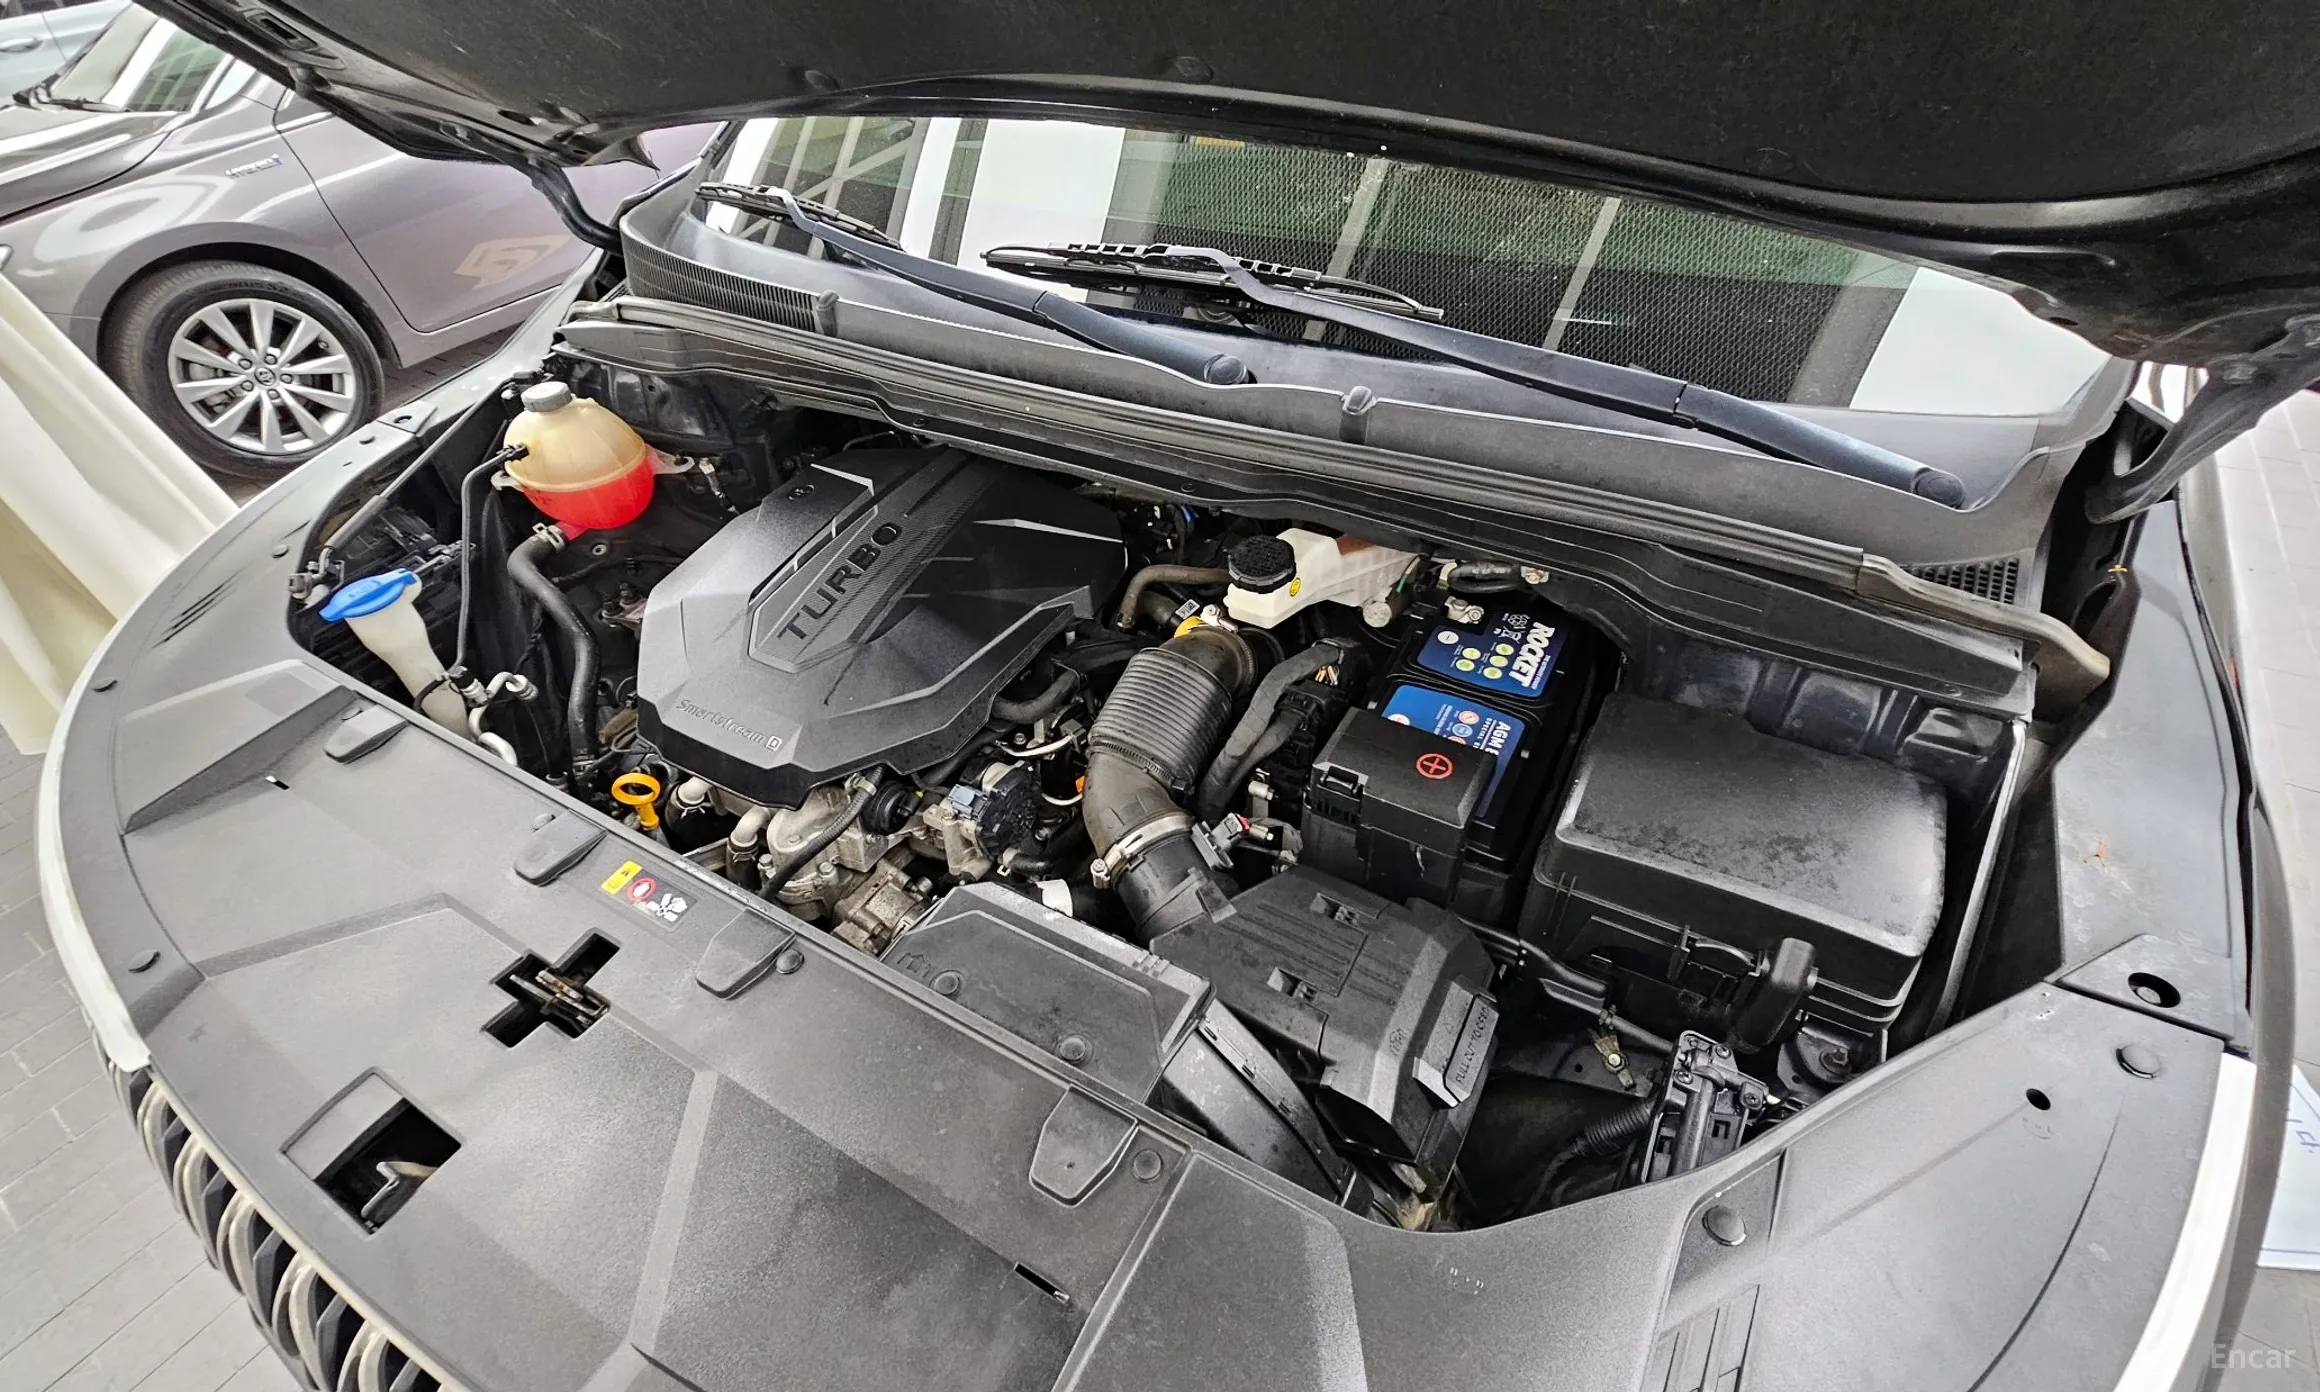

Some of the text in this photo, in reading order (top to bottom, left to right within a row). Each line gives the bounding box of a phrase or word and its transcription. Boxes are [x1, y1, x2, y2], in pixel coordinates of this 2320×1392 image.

[777, 521, 903, 640] TURBO
[1508, 621, 1555, 688] ROCKET
[675, 699, 781, 750] Smartstream D
[1488, 721, 1511, 749] AGM
